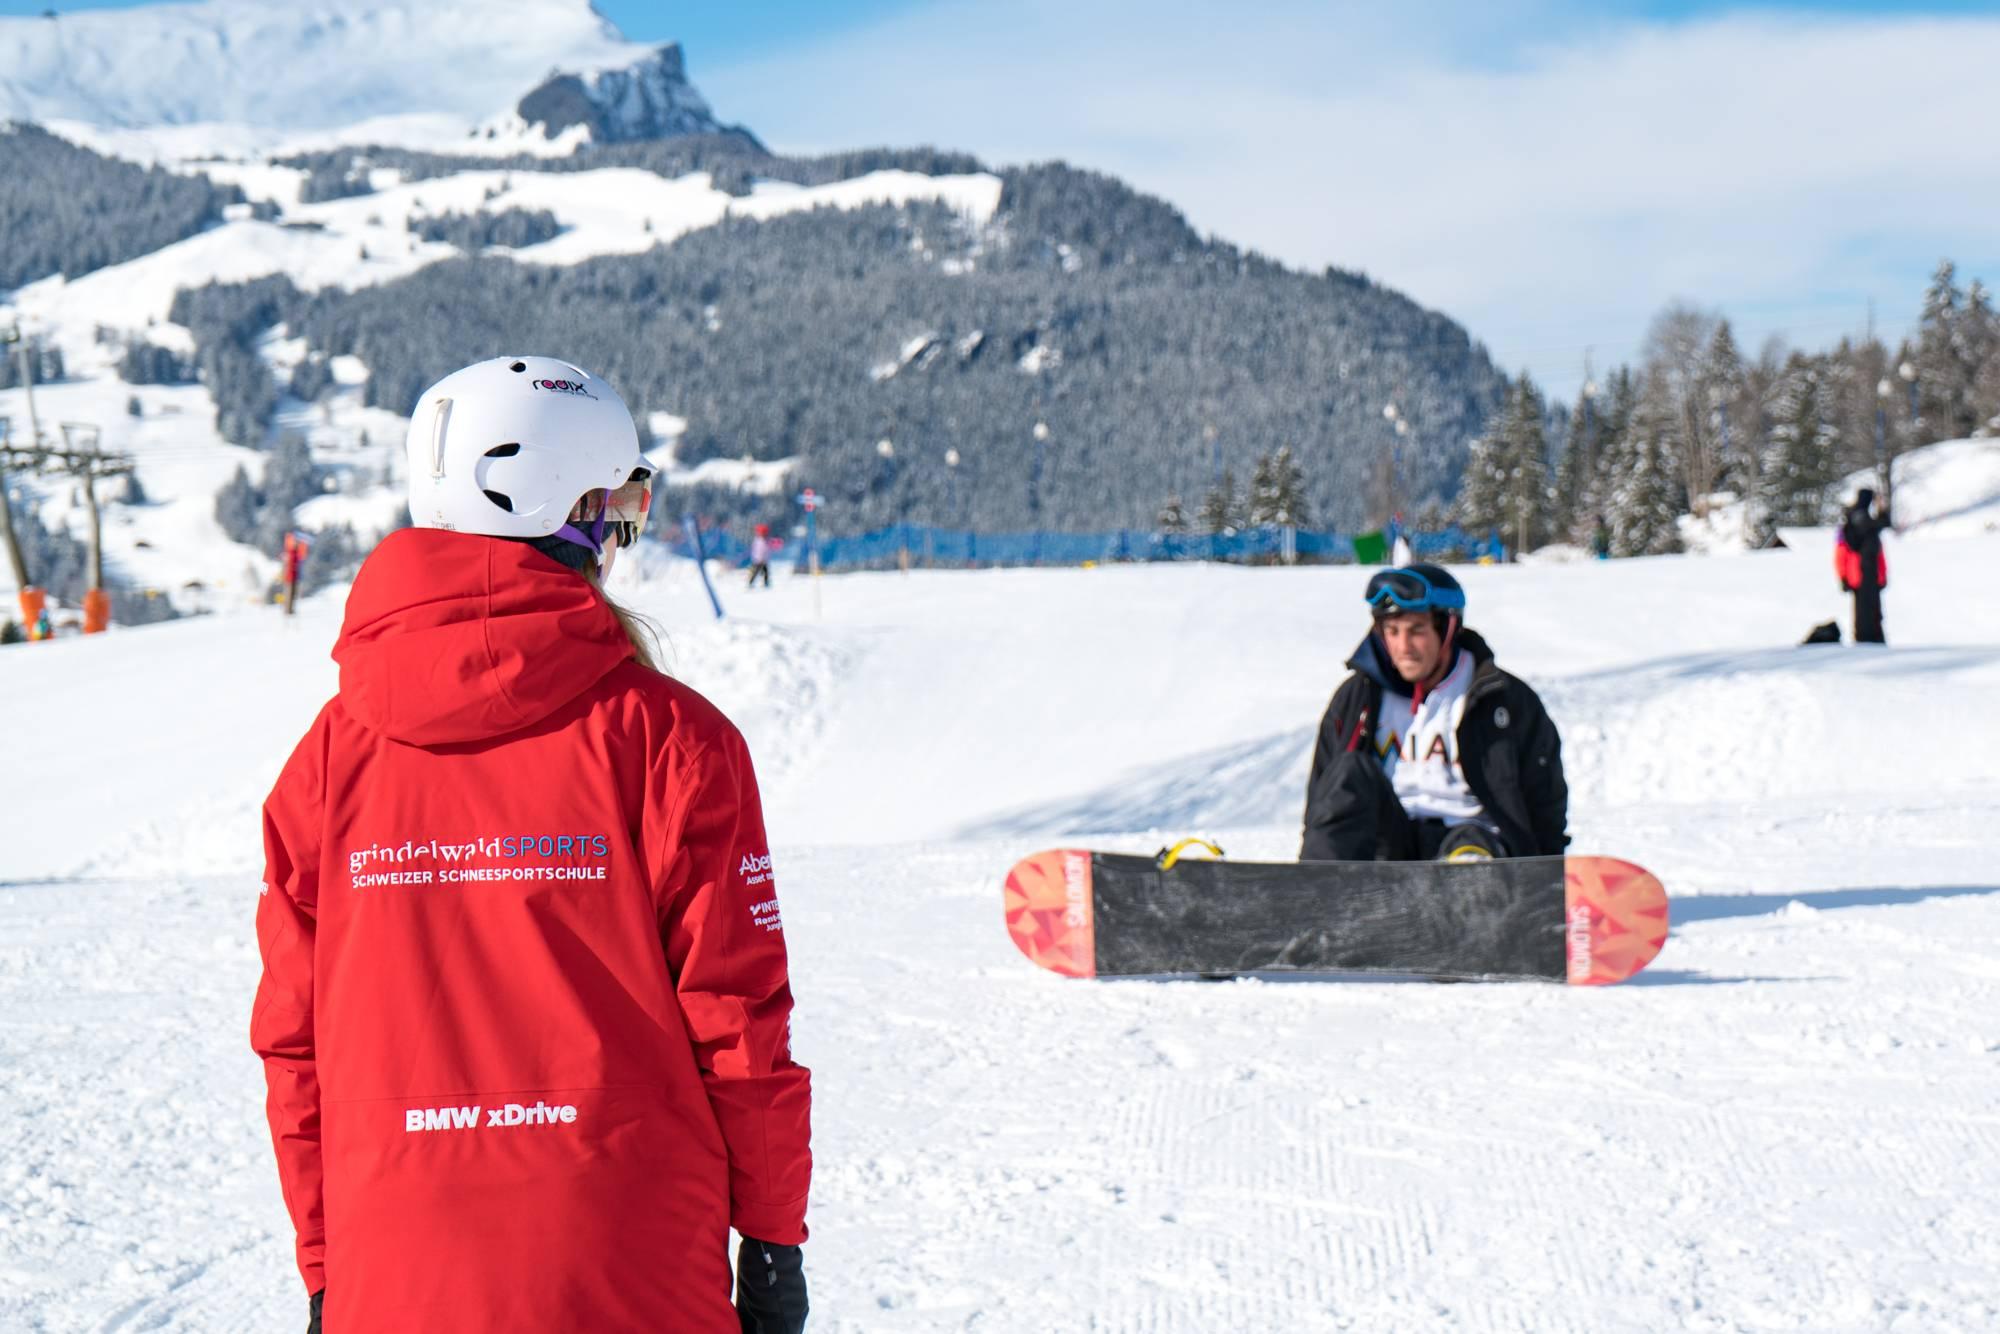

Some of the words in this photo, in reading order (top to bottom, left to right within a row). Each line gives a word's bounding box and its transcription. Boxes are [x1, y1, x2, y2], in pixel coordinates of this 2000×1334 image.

[352, 870, 433, 888] SCHWEIZER
[440, 866, 606, 884] SCHNEESPORTSCHULE
[1569, 905, 1592, 977] SALOMON
[405, 1105, 481, 1132] BMW
[486, 1101, 578, 1128] xDrive
